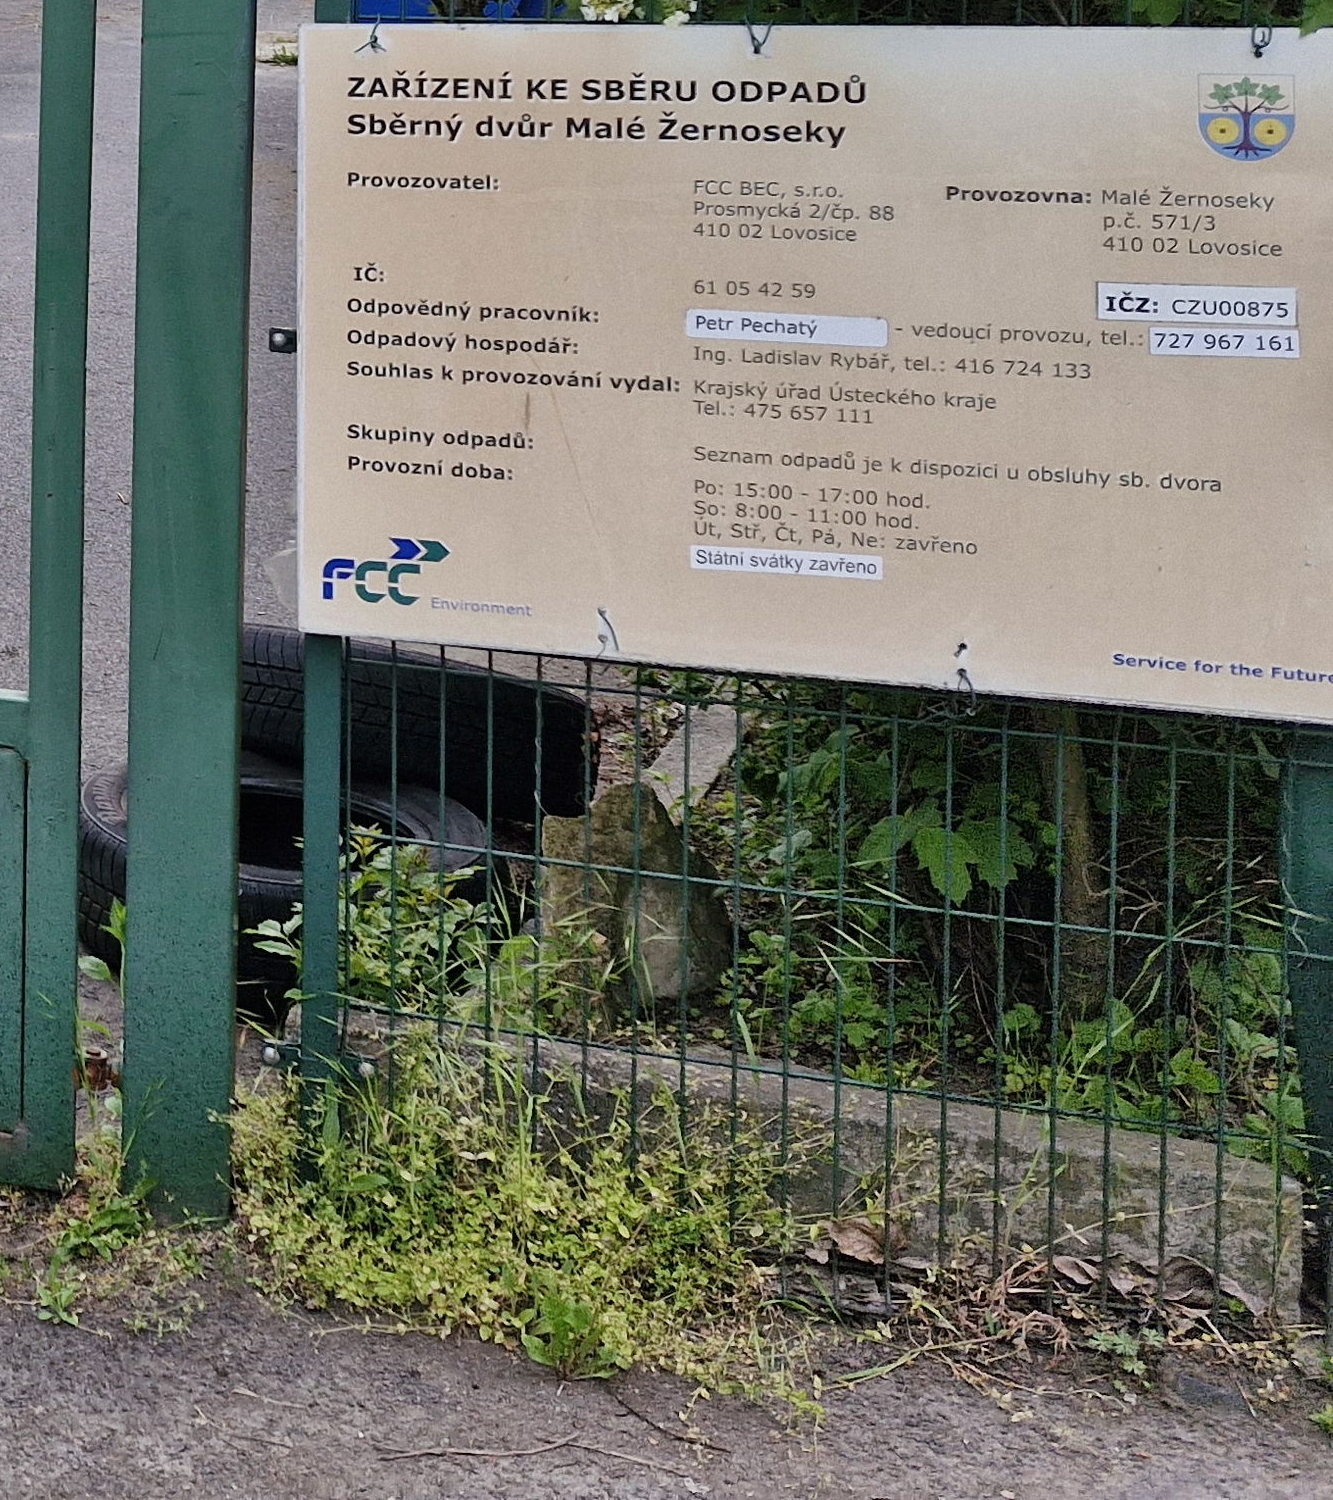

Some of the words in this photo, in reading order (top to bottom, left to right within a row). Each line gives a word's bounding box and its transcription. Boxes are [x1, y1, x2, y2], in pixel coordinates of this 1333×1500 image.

[347, 71, 513, 99] ZAŘÍZENÍ
[527, 78, 568, 100] KE
[582, 72, 697, 102] SBĚRU
[712, 74, 866, 104] ODPADŮ
[347, 113, 462, 142] Sběrný
[475, 114, 552, 139] dvůr
[567, 115, 645, 140] Malé
[658, 112, 846, 147] Žernoseky
[347, 172, 499, 190] Provozovatel:
[694, 180, 731, 196] FCC
[739, 181, 786, 200] BEC,
[795, 184, 843, 198] s.r.o.
[946, 186, 1092, 204] Provozovna:
[1102, 189, 1150, 205] Malé
[1159, 186, 1275, 212] Žernoseky
[693, 201, 801, 221] Prosmycká
[809, 202, 860, 224] 2/čp.
[871, 204, 894, 221] 88
[1103, 213, 1141, 232] p.č.
[1152, 214, 1215, 233] 571/3
[693, 222, 731, 238] 410
[739, 223, 762, 239] 02
[772, 224, 857, 241] Lovosice
[1103, 237, 1143, 252] 410
[1153, 239, 1179, 253] 02
[1189, 239, 1282, 256] Lovosice
[354, 263, 385, 282] IČ:
[694, 280, 717, 294] 61
[726, 281, 750, 296] 05
[758, 282, 783, 297] 42
[792, 283, 815, 298] 59
[347, 298, 471, 321] Odpovědný
[479, 305, 599, 325] pracovník:
[1106, 291, 1158, 313] IČZ:
[1172, 299, 1288, 317] CZU00875
[347, 329, 456, 353] Odpadový
[466, 334, 579, 355] hospodář:
[696, 315, 733, 332] Petr
[741, 317, 818, 339] Pechatý
[912, 324, 991, 339] vedoucí
[1000, 327, 1092, 346] provozu,
[1101, 330, 1143, 346] tel.:
[1154, 333, 1191, 349] 727
[1204, 334, 1244, 350] 967
[1256, 336, 1294, 351] 161
[694, 346, 733, 365] Ing.
[741, 348, 822, 367] Ladislav
[831, 352, 896, 373] Rybář,
[904, 355, 945, 373] tel.:
[955, 359, 995, 376] 416
[1004, 361, 1043, 377] 724
[1053, 362, 1091, 379] 133
[347, 361, 433, 379] Souhlas
[442, 365, 453, 380] k
[462, 368, 601, 388] provozování
[610, 374, 681, 393] vydal:
[694, 379, 767, 401] Krajský
[775, 381, 821, 401] úřad
[829, 381, 935, 407] Ústeckého
[944, 392, 997, 412] kraje
[694, 401, 734, 417] Tel.:
[744, 403, 781, 419] 475
[790, 405, 827, 421] 657
[837, 407, 872, 423] 111
[347, 424, 435, 446] Skupiny
[444, 429, 534, 450] odpadů:
[348, 456, 443, 477] Provozní
[452, 461, 513, 480] doba:
[694, 446, 773, 465] Seznam
[781, 451, 855, 473] odpadů
[864, 456, 882, 474] je
[891, 458, 902, 473] k
[910, 459, 998, 480] dispozici
[1007, 469, 1018, 480] u
[1029, 468, 1110, 489] obsluhy
[1119, 471, 1150, 487] sb.
[1160, 474, 1222, 492] dvora
[694, 480, 723, 496] Po:
[735, 482, 792, 500] 15:00
[819, 488, 878, 505] 17:00
[887, 493, 930, 510] hod.
[694, 500, 726, 517] So:
[736, 503, 782, 521] 8:00
[808, 508, 866, 526] 11:00
[876, 513, 919, 530] hod.
[694, 518, 722, 540] Út,
[730, 522, 766, 542] Stř,
[775, 522, 803, 545] Čt,
[812, 528, 841, 547] Pá,
[851, 532, 885, 548] Ne:
[895, 533, 977, 555] zavřeno
[696, 549, 744, 568] Státní
[750, 553, 803, 572] svátky
[809, 557, 877, 576] zavřeno
[323, 558, 421, 606] FCC
[431, 597, 532, 617] Environment
[1113, 653, 1186, 671] Service
[1194, 660, 1223, 674] for
[1230, 663, 1263, 677] the
